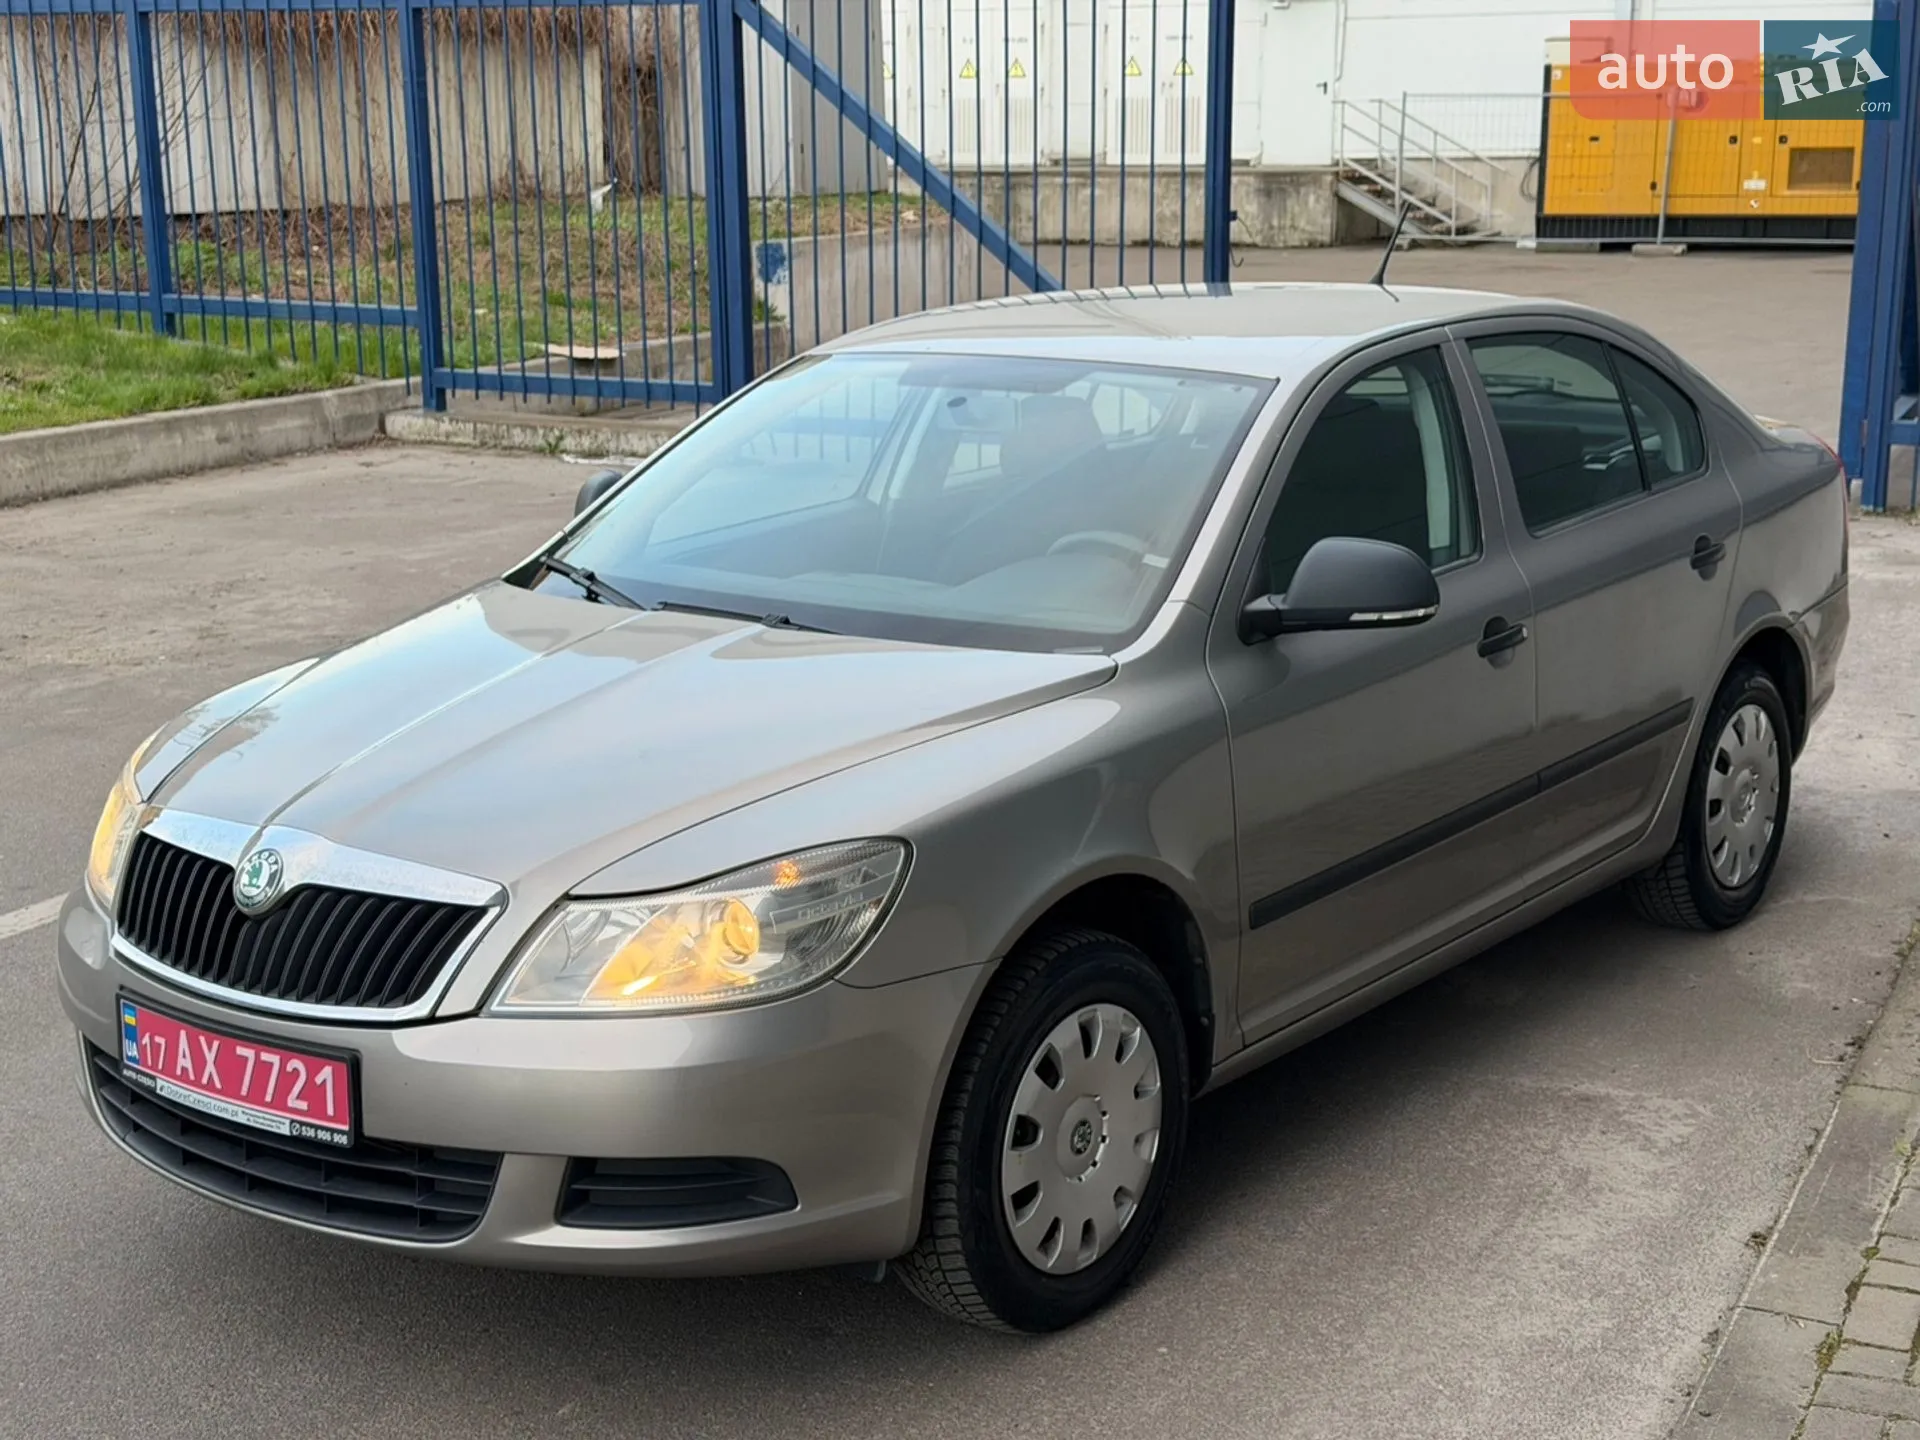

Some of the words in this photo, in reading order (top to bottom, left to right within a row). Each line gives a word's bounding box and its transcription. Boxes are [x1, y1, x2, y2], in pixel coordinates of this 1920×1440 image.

[125, 1039, 140, 1060] UA
[141, 1031, 166, 1071] 17
[176, 1029, 222, 1089] AX
[235, 1045, 334, 1117] 7721
